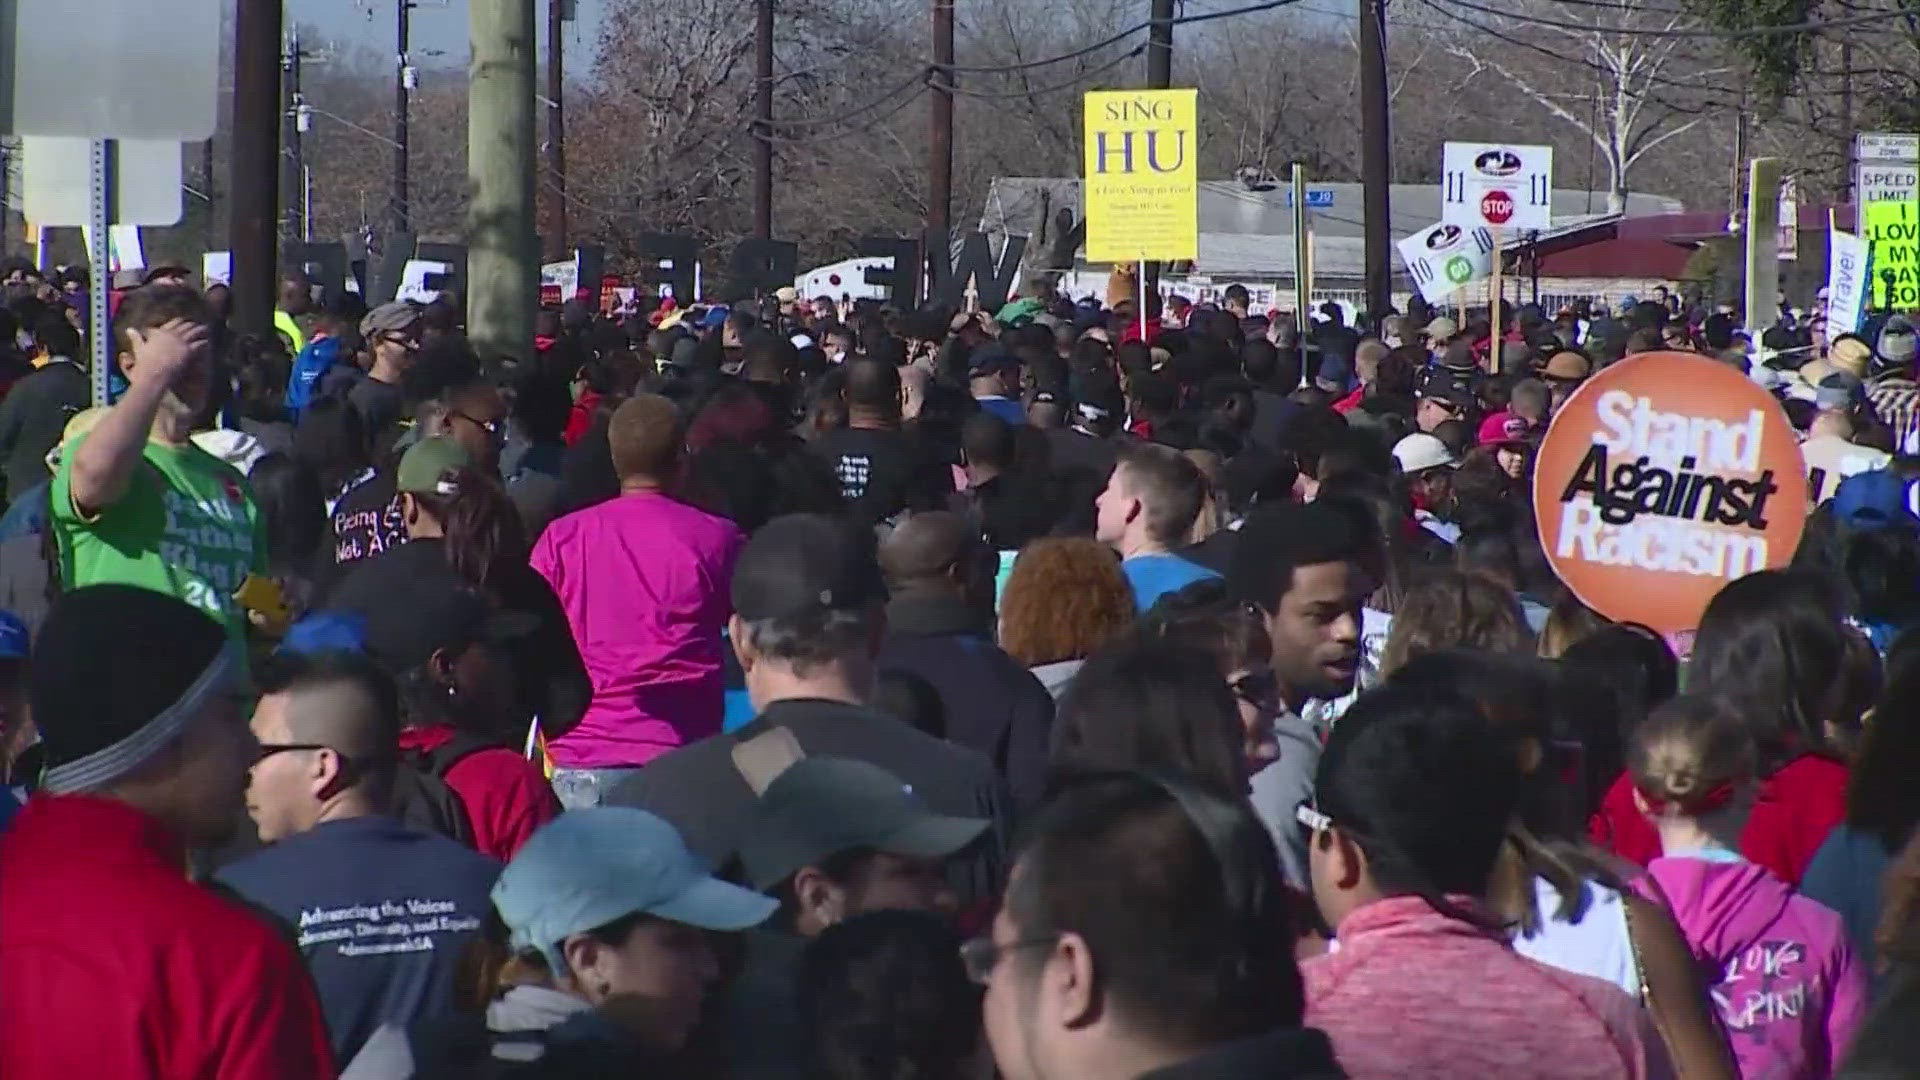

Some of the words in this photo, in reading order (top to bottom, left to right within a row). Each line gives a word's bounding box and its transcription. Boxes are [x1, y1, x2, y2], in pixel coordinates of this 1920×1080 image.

[1106, 99, 1172, 121] SING
[1095, 129, 1189, 174] HU
[1447, 171, 1464, 203] 11
[1530, 173, 1549, 205] 11
[1863, 173, 1916, 186] SPEED
[1483, 200, 1514, 213] STOP
[1868, 190, 1909, 201] LIMIT
[1472, 226, 1494, 255] 10
[1412, 256, 1434, 285] 10
[1450, 262, 1468, 278] GO
[1831, 250, 1855, 314] Travel
[1593, 390, 1765, 472] Stand
[1560, 444, 1778, 531] Against
[1556, 499, 1768, 580] Racism
[301, 906, 380, 927] Advancing
[381, 900, 405, 917] the
[407, 899, 456, 915] Voices
[1725, 940, 1800, 983] LOVE
